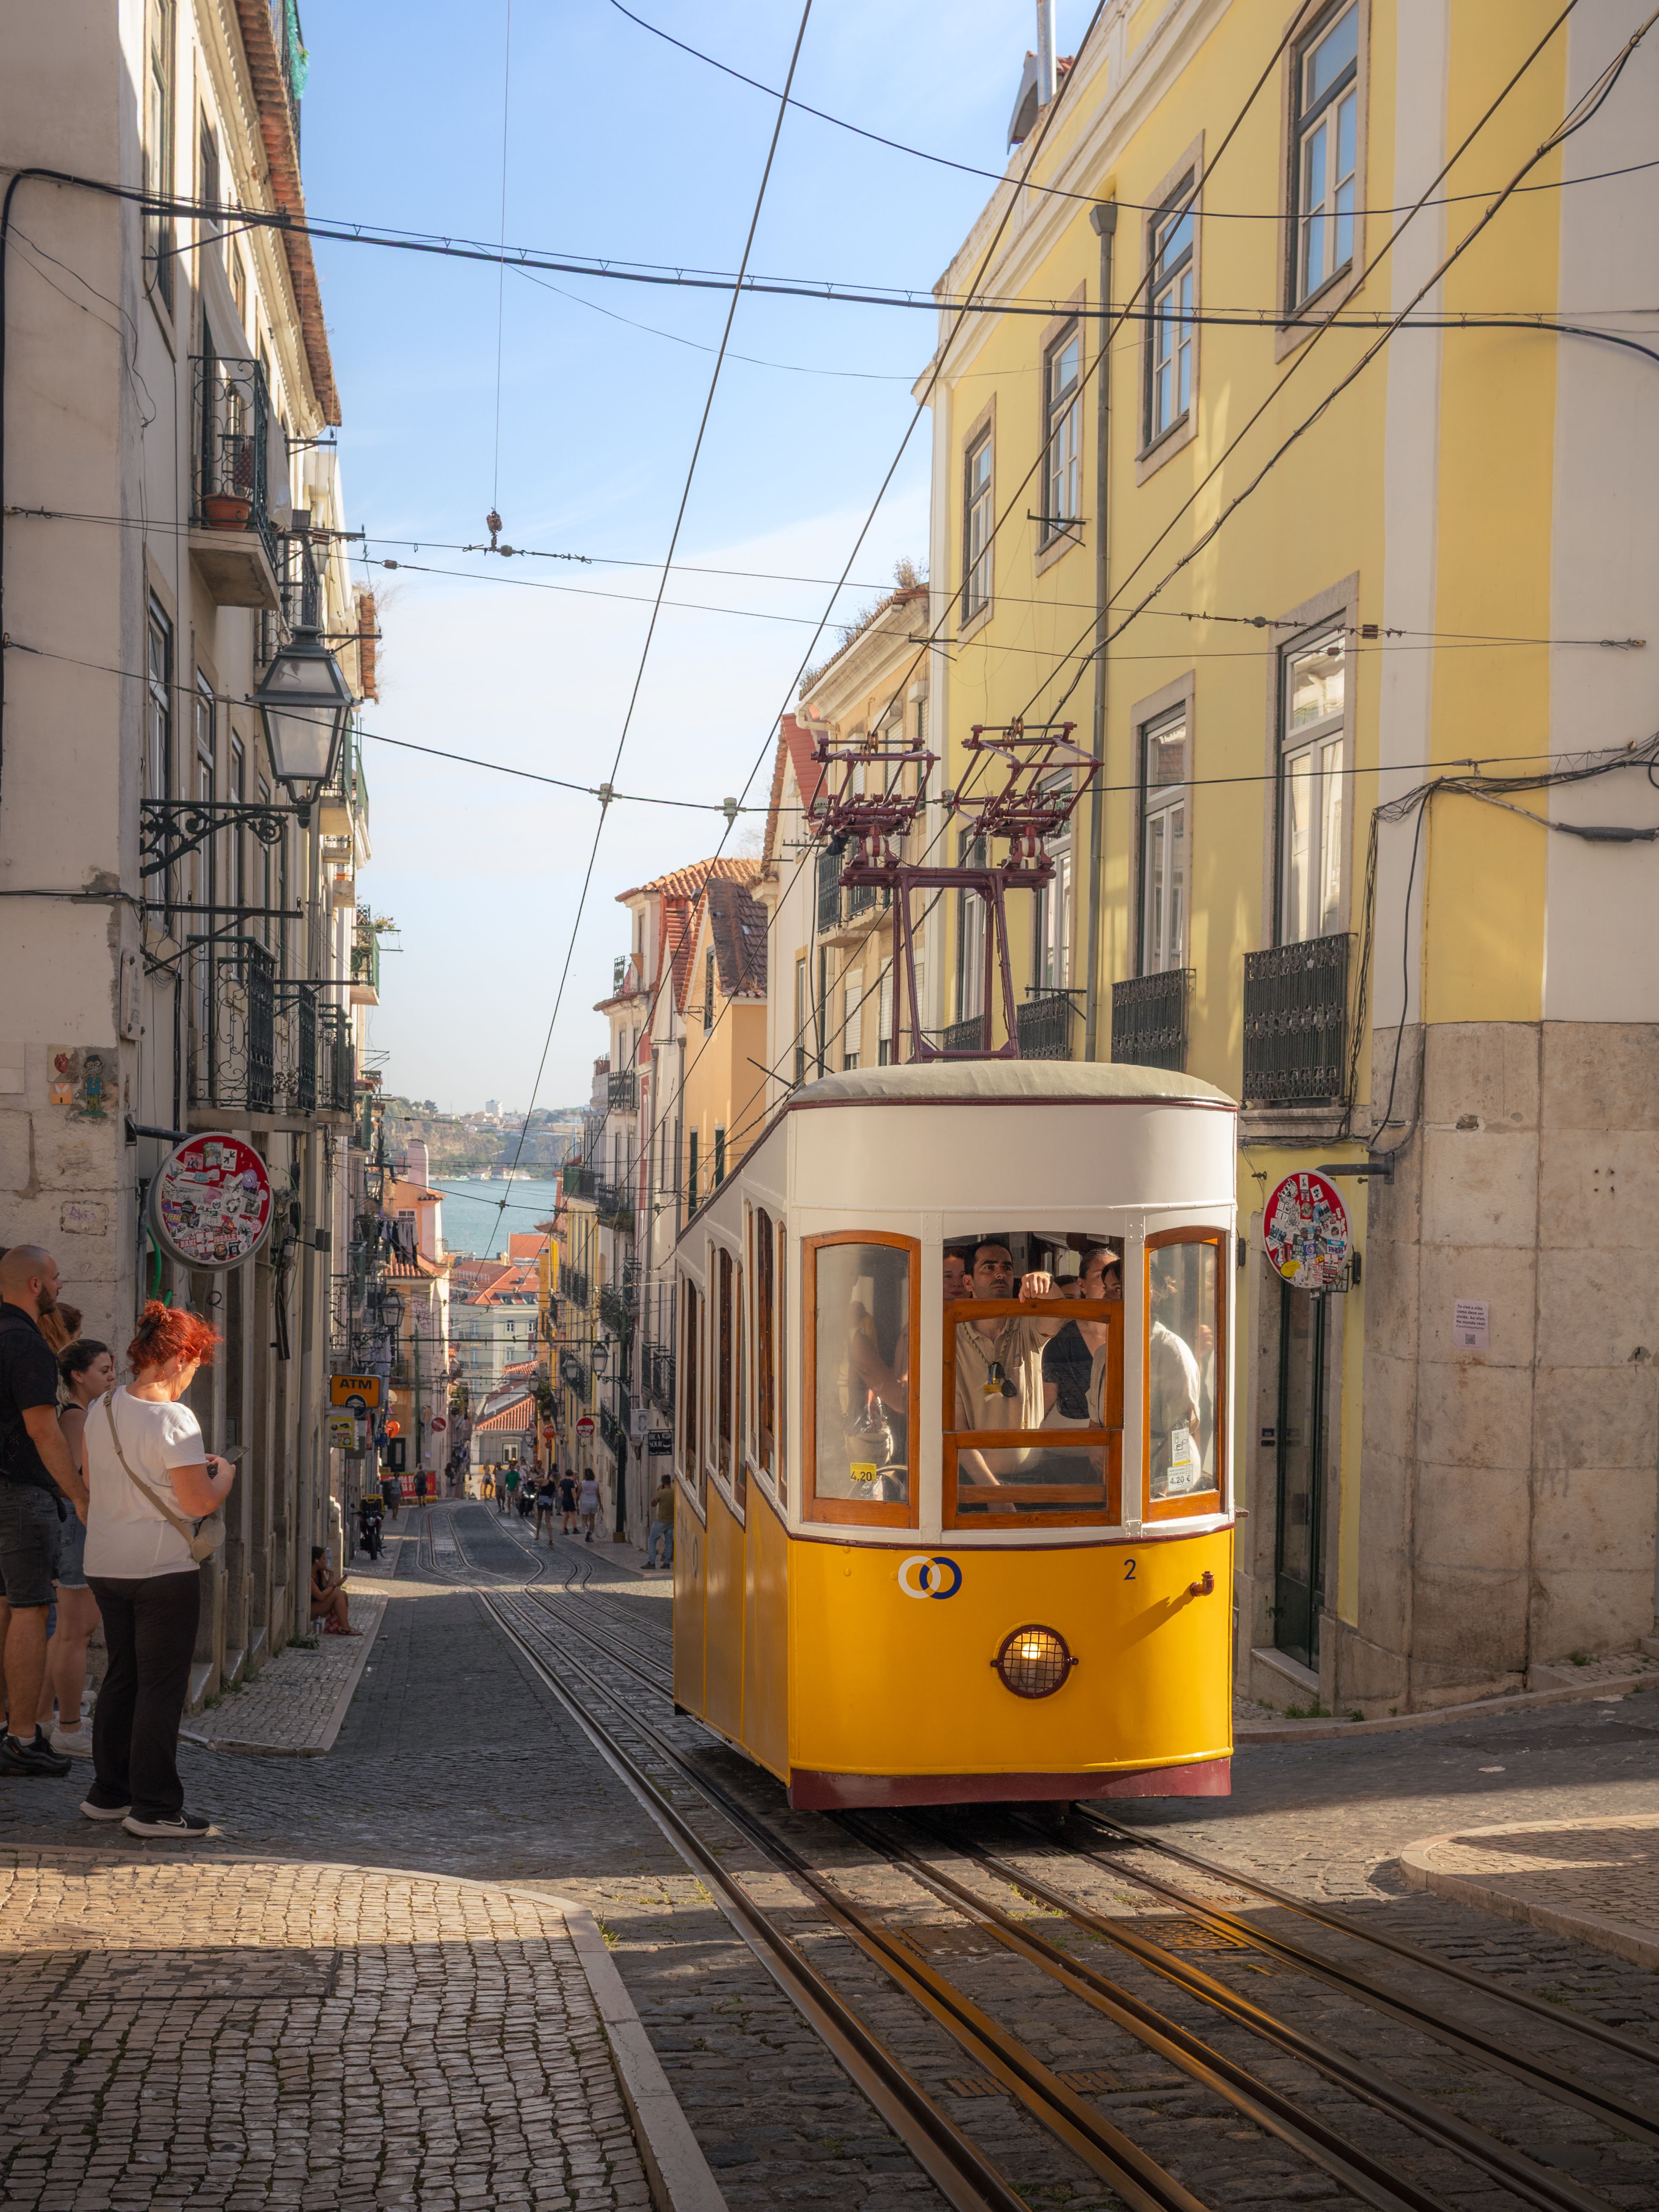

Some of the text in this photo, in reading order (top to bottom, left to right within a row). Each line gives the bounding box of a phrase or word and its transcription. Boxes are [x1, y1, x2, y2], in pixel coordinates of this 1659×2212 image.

[340, 1378, 372, 1389] ATM
[851, 1471, 872, 1481] 4.20
[1170, 1476, 1184, 1484] 4.20
[1124, 1558, 1136, 1580] 2
